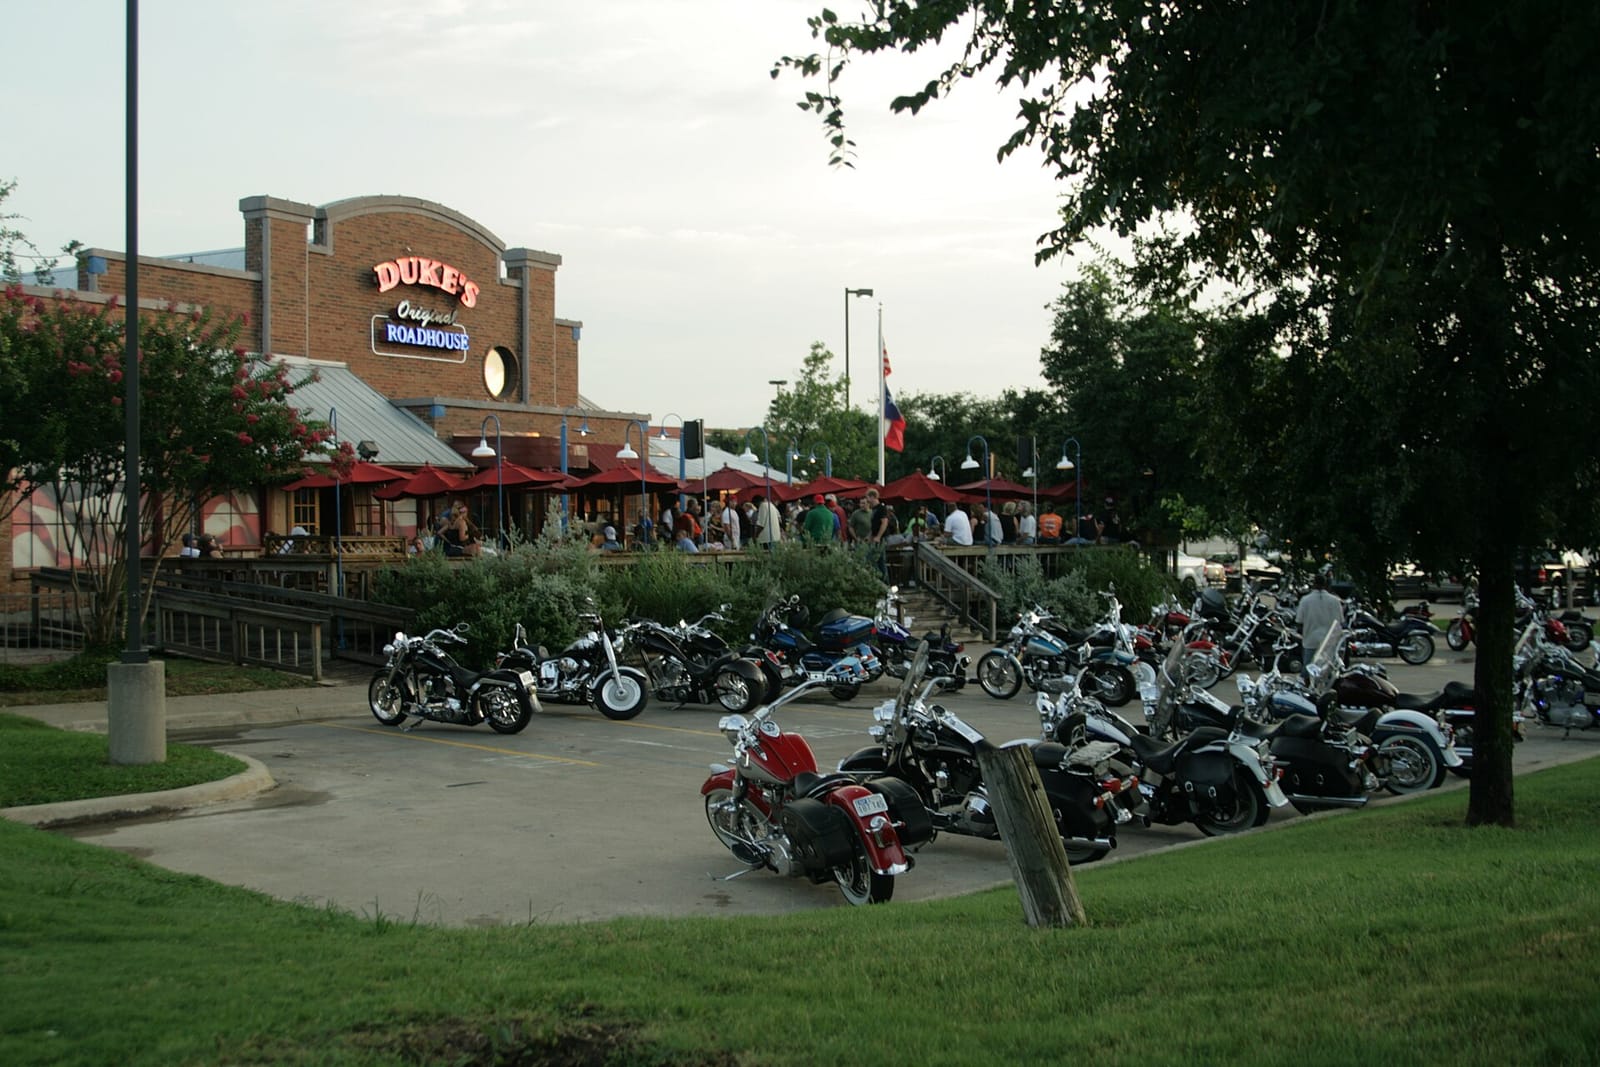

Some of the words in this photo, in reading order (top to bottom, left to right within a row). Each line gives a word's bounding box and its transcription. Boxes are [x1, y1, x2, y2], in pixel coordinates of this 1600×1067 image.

[373, 257, 480, 308] DUKE'S
[397, 300, 457, 327] Original
[386, 324, 469, 350] ROADHOUSE
